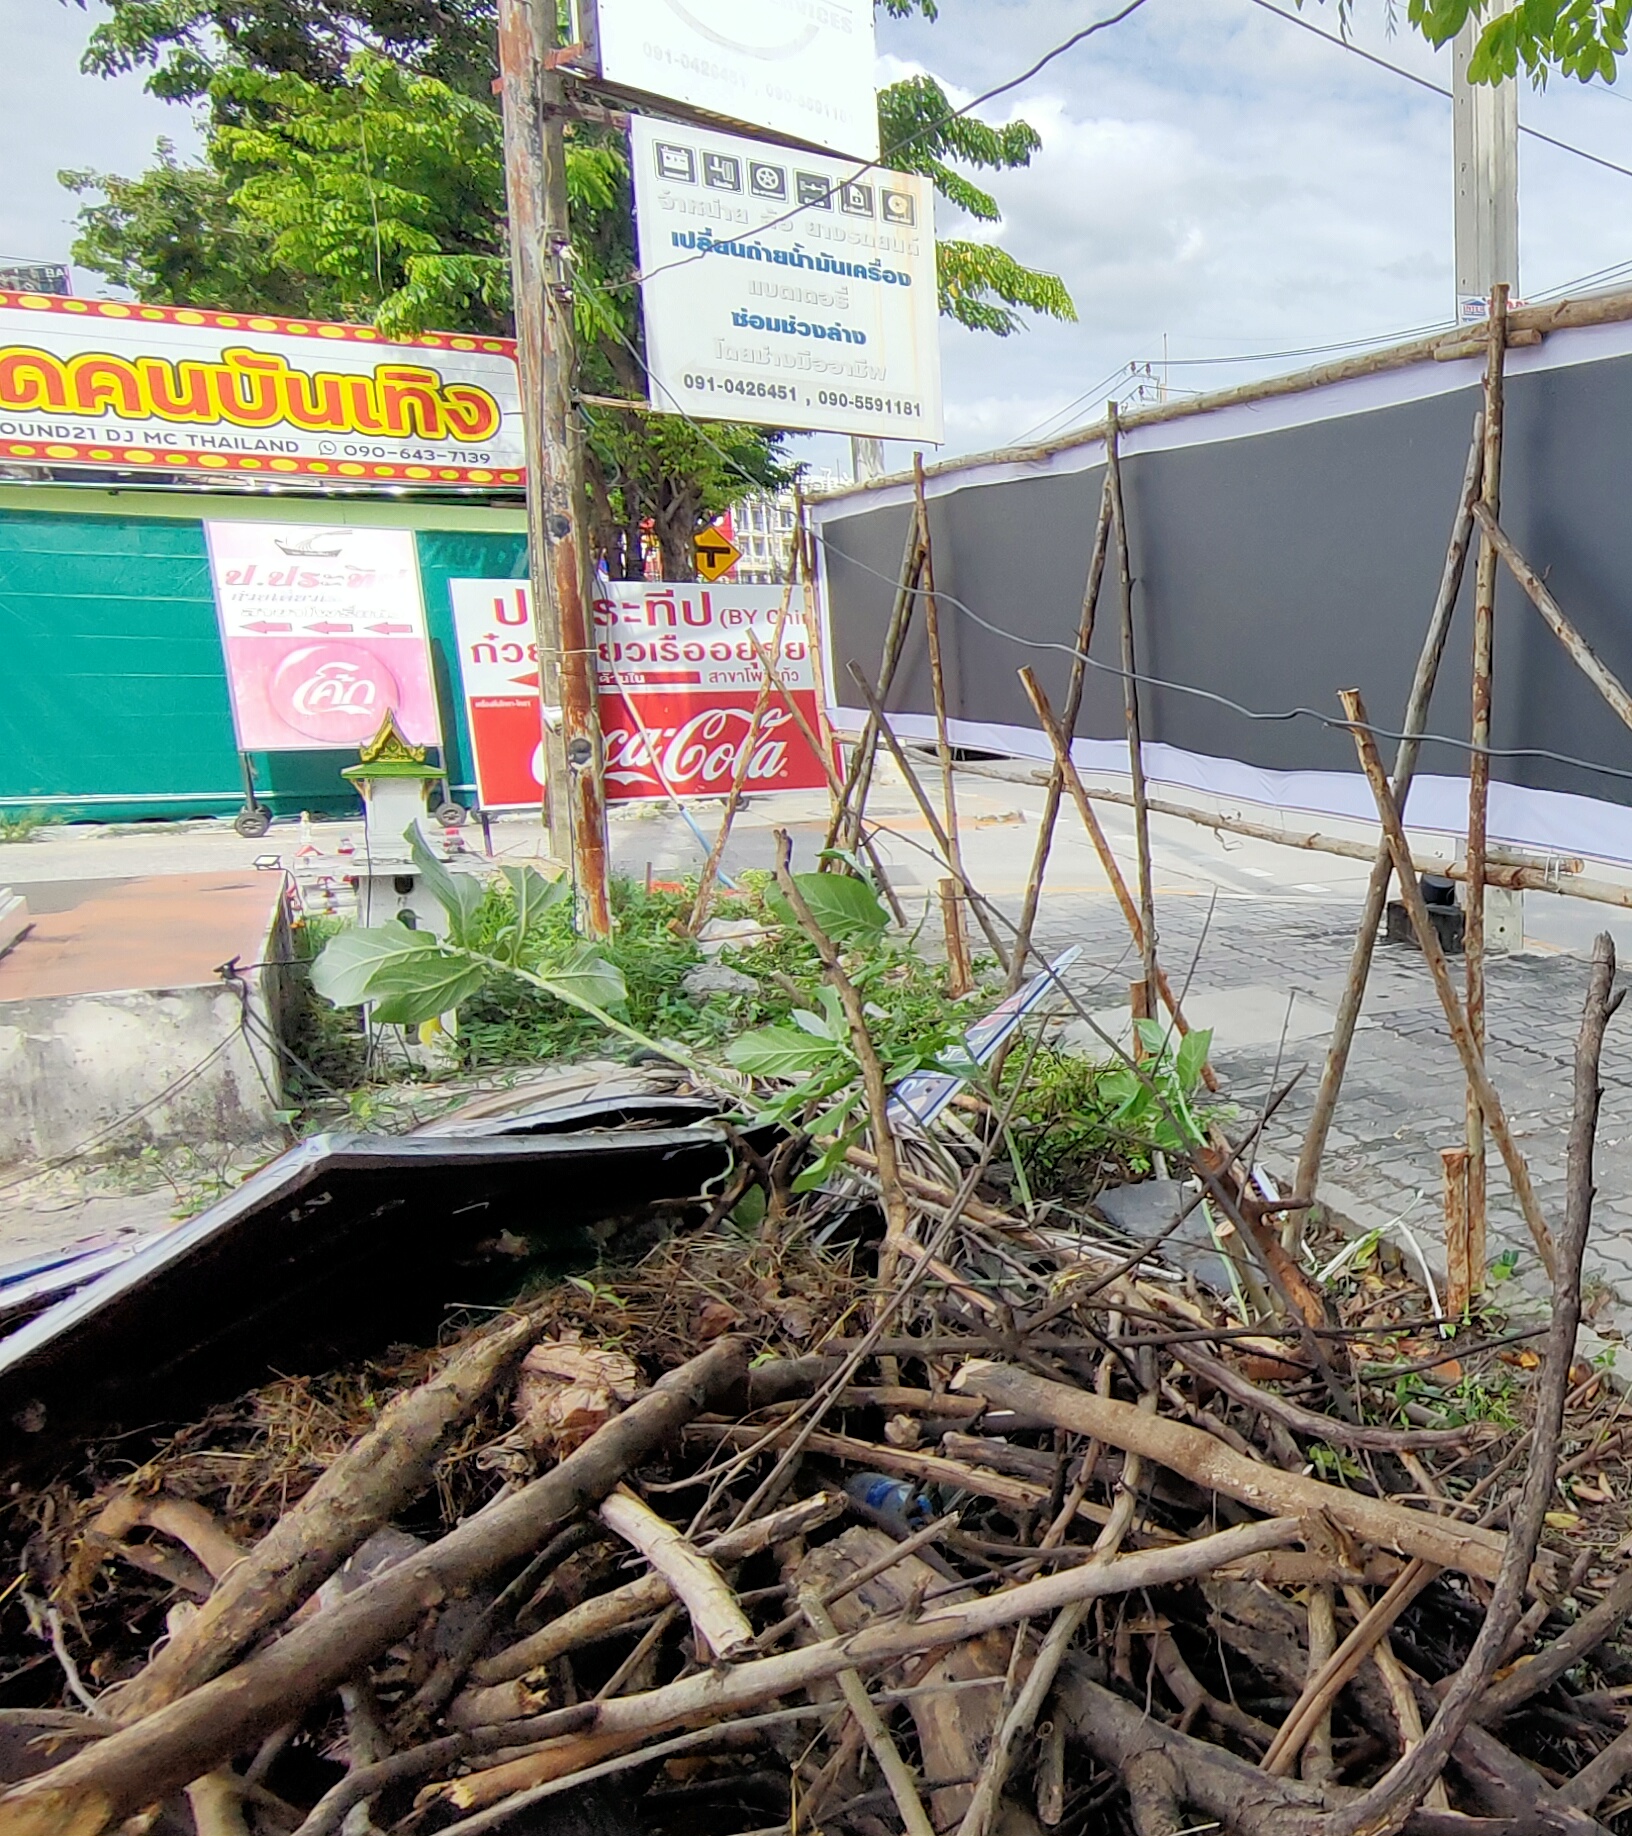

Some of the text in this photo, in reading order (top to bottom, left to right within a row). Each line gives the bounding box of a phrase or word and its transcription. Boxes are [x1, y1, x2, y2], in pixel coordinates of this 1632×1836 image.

[731, 308, 867, 345] ซ่อมช่วงล่าง
[683, 373, 797, 401] 091-0426451
[818, 391, 921, 417] 090-5591181
[106, 429, 134, 443] DJ
[144, 431, 177, 445] MC
[186, 434, 299, 453] THAILAND
[344, 444, 491, 465] 090-643-7139
